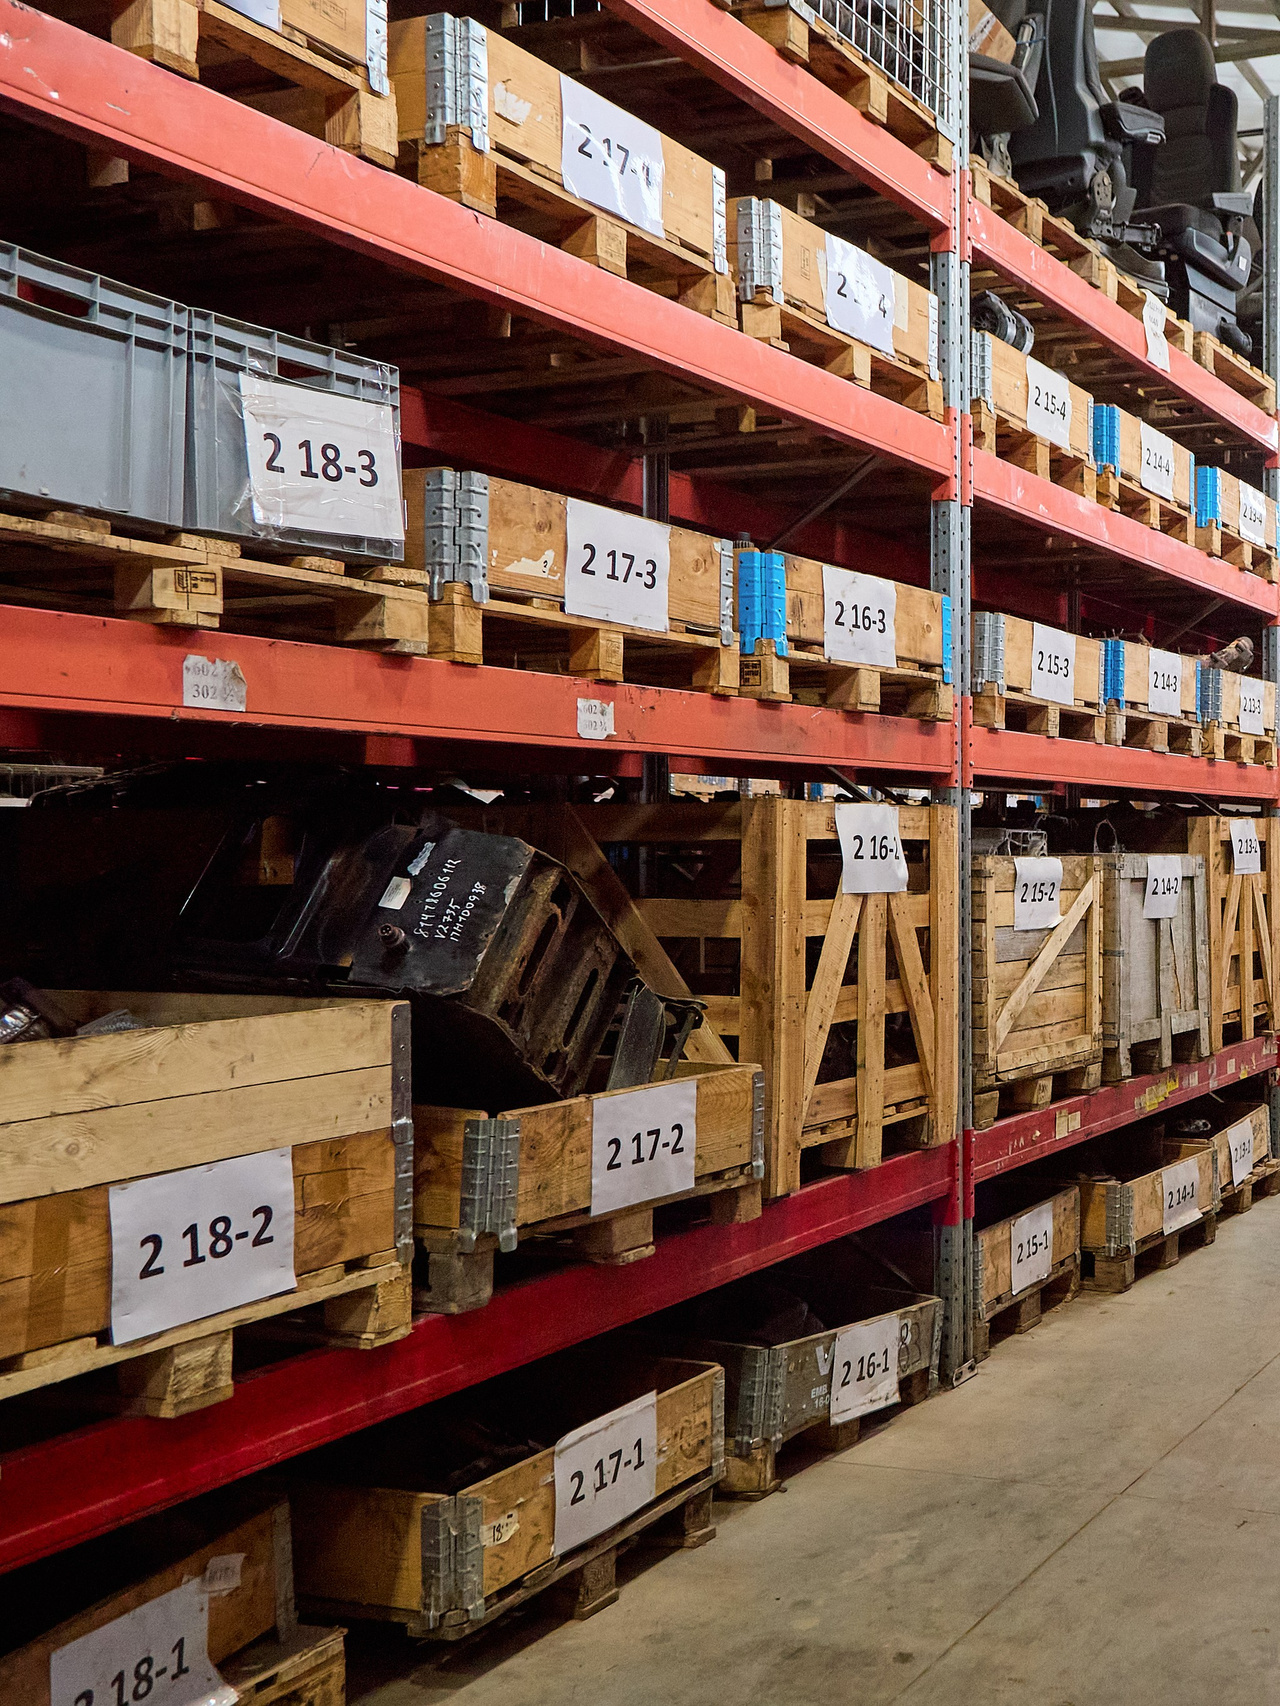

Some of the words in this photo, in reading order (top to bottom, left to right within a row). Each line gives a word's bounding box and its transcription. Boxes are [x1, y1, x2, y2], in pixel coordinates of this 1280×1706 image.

[578, 124, 593, 159] 2
[837, 272, 847, 298] 2
[1034, 386, 1041, 407] 2
[1044, 392, 1067, 421] 15-4
[263, 432, 285, 473] 2
[298, 440, 379, 487] 18-3
[1146, 448, 1151, 466] 2
[1153, 452, 1170, 476] 14-4
[1243, 503, 1248, 518] 2
[581, 544, 596, 576] 2
[606, 550, 657, 589] 17-3
[834, 600, 845, 627] 2
[851, 604, 887, 634] 16-3
[1037, 650, 1044, 671] 2
[1047, 653, 1070, 678] 15-3
[1153, 671, 1159, 688] 2
[1161, 674, 1178, 692] 14-3
[1243, 697, 1248, 711] 2
[853, 834, 864, 860] 2
[1238, 838, 1243, 854] 2
[1020, 882, 1029, 903] 2
[1031, 881, 1055, 903] 15-2
[1151, 877, 1159, 895] 2
[1161, 877, 1179, 895] 14-2
[434, 898, 461, 939] V2735
[607, 1137, 622, 1170] 2
[632, 1123, 684, 1165] 17-2
[1234, 1147, 1239, 1163] 2
[1168, 1190, 1174, 1209] 2
[1176, 1182, 1195, 1206] 14-1
[139, 1233, 165, 1280] 2
[182, 1205, 274, 1268] 18-2
[1016, 1243, 1024, 1265] 2
[1026, 1230, 1049, 1259] 15-1
[840, 1360, 851, 1388] 2
[856, 1348, 889, 1382] 16-1
[570, 1470, 586, 1506] 2
[594, 1437, 645, 1494] 17-1
[111, 1637, 190, 1706] 18-1
